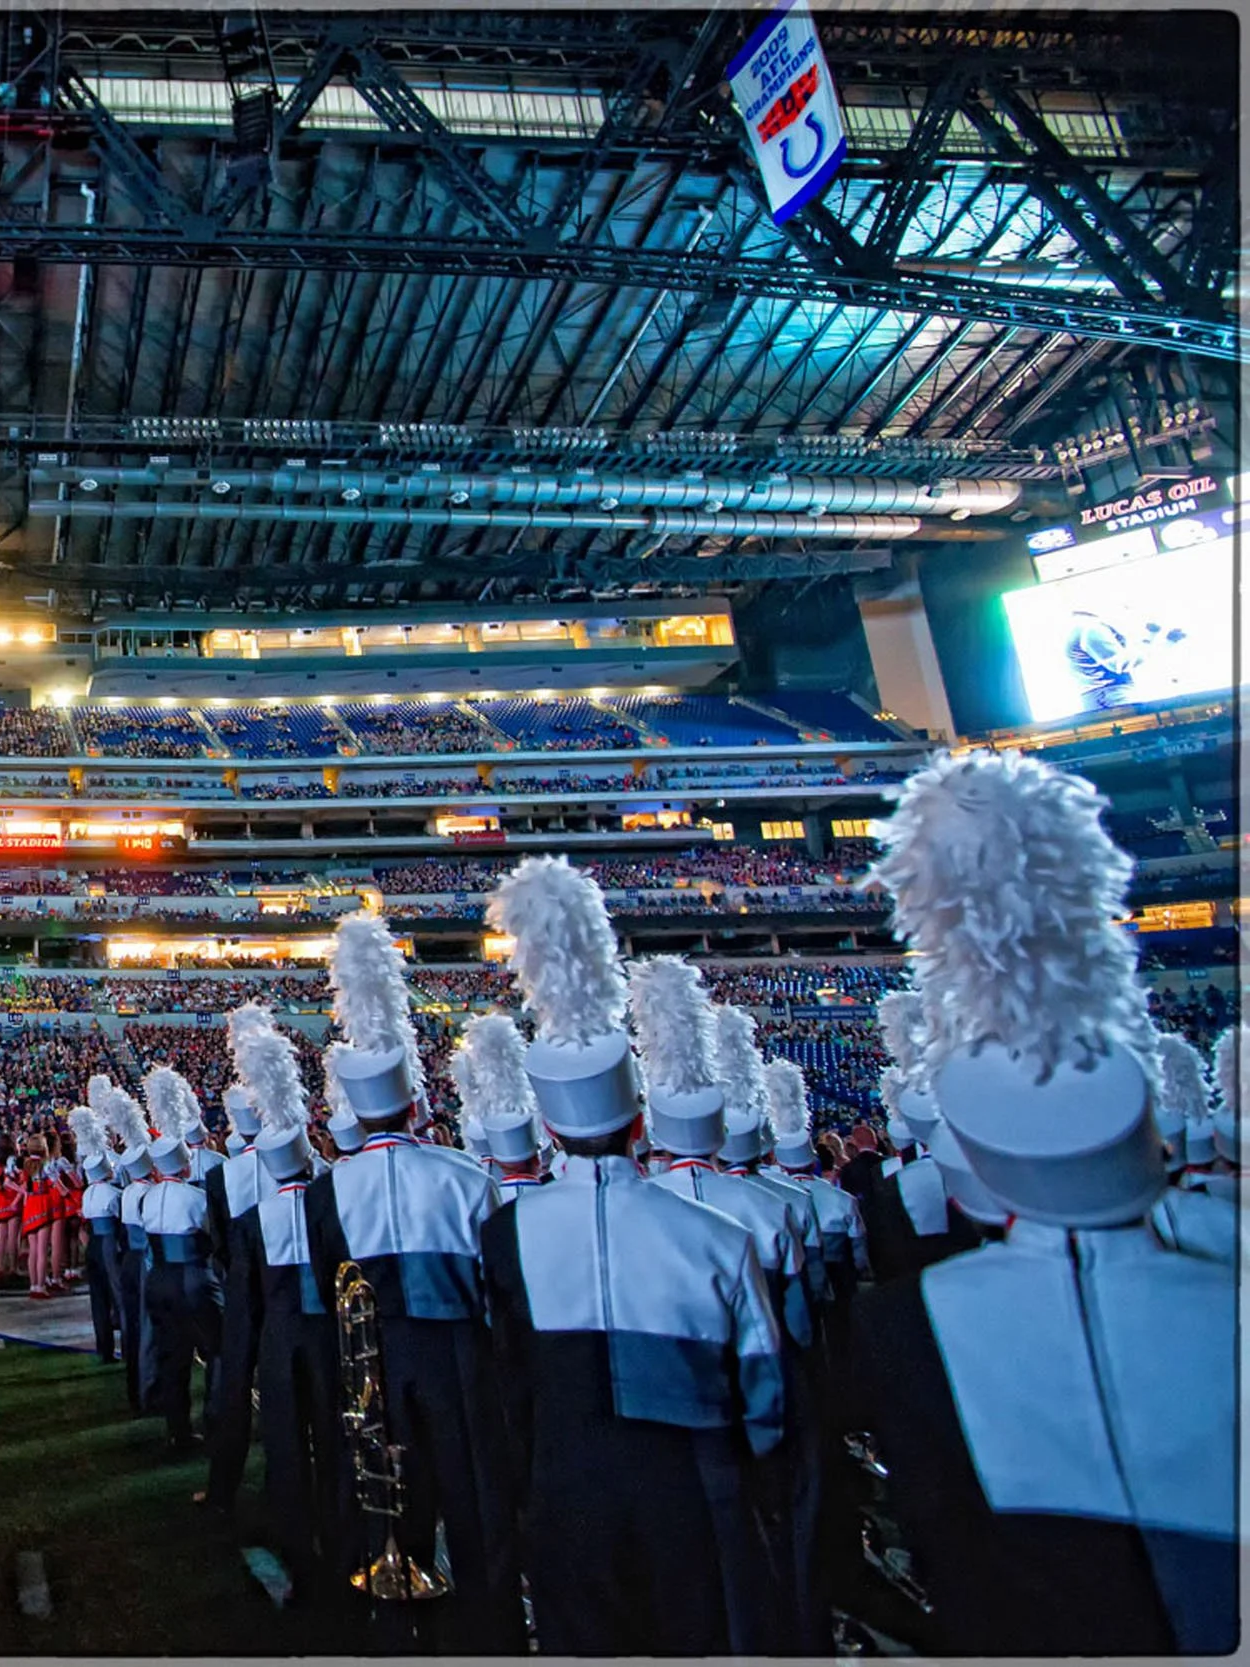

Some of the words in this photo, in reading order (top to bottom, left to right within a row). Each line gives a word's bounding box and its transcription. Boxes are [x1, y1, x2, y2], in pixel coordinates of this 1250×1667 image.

[750, 26, 789, 79] 2009
[761, 46, 791, 90] AFC
[745, 36, 816, 121] CHAMPIONS
[1080, 490, 1162, 525] LUCAS
[1168, 476, 1216, 501] OIL
[1105, 498, 1197, 532] STADIUM
[6, 838, 62, 848] STADIUM
